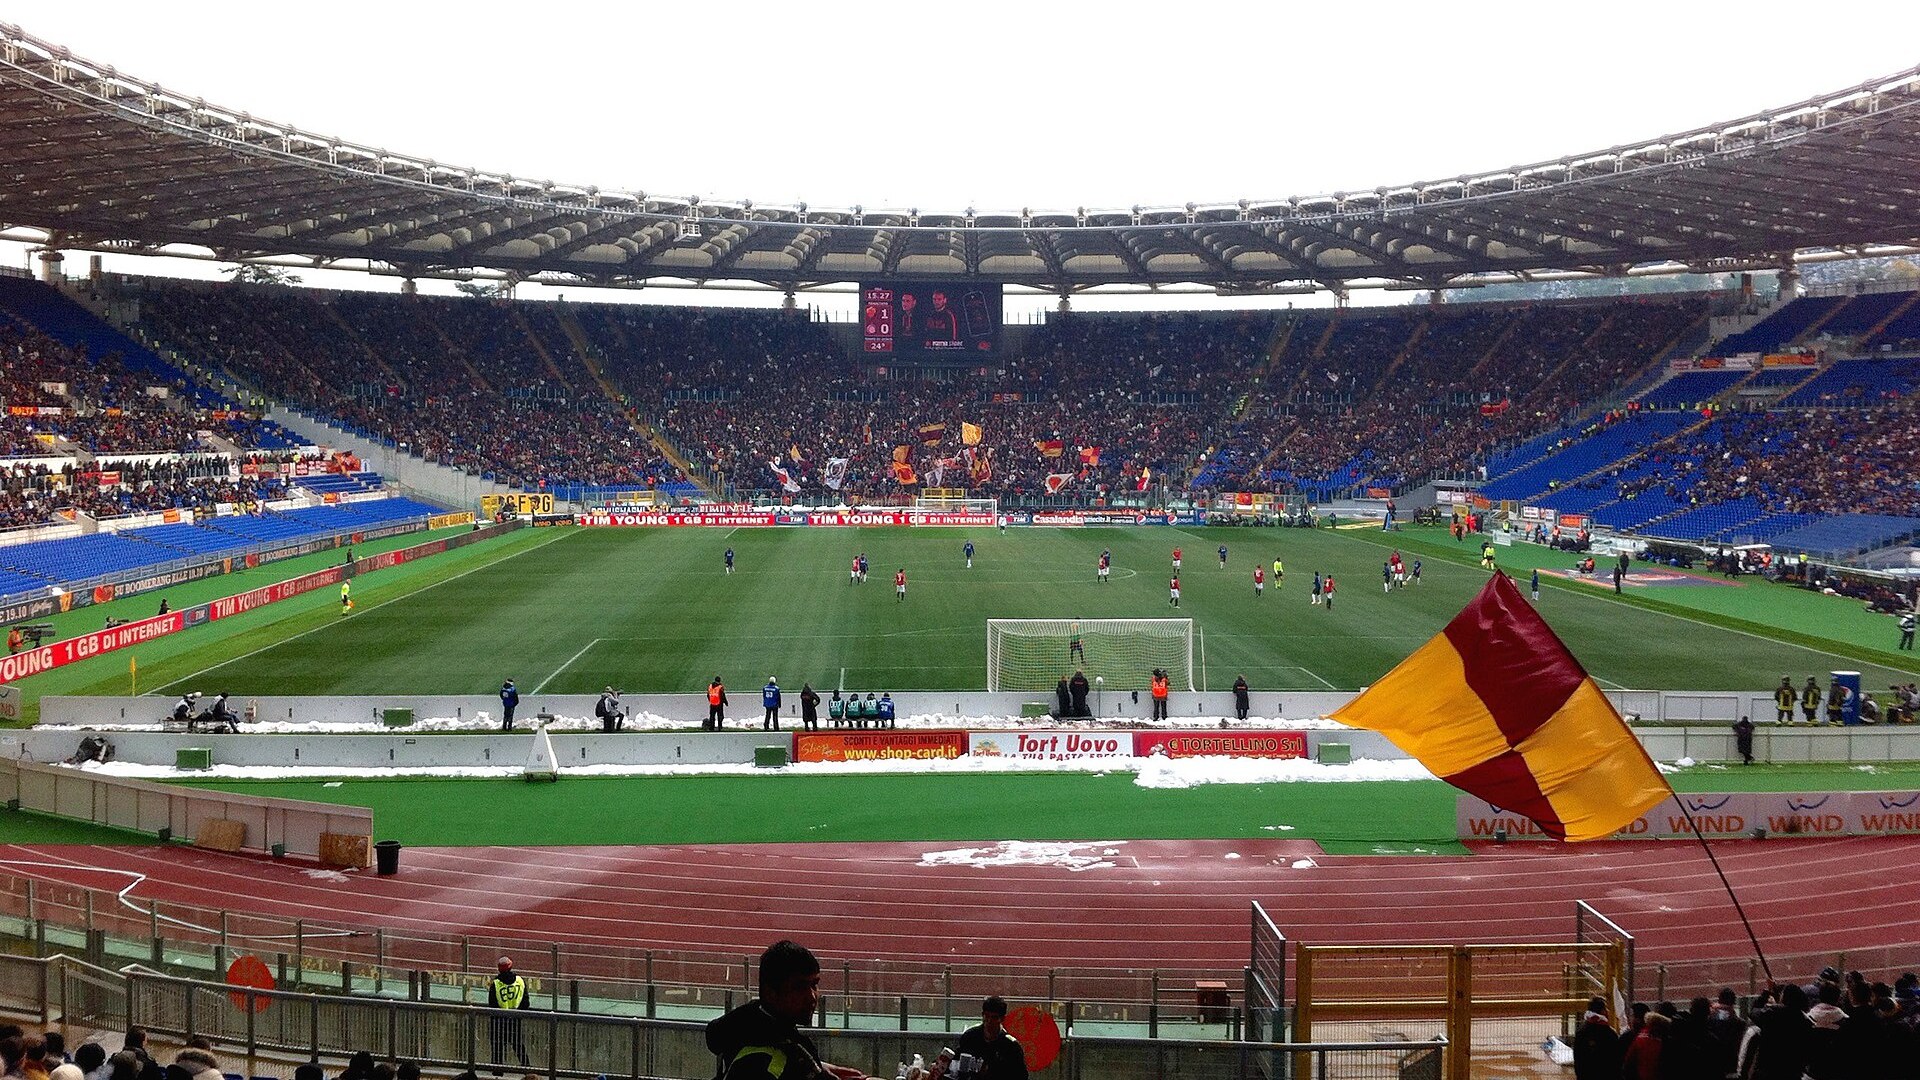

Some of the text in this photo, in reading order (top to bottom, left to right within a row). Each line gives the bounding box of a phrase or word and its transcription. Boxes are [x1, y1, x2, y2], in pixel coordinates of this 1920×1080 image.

[881, 308, 889, 319] 1
[880, 323, 889, 334] 0
[583, 515, 611, 525] TIM
[615, 515, 669, 525] YOUNG
[674, 516, 680, 525] 1
[683, 516, 702, 524] GB
[811, 515, 993, 525] TIM YOUNG 1 GB DI INTERNET
[1032, 514, 1084, 524] Casalandia
[125, 574, 171, 594] BOOMERANG
[215, 599, 235, 618] TIM
[238, 588, 270, 613] YOUNG
[283, 580, 295, 597] GB
[6, 605, 28, 622] 19.10
[65, 643, 73, 661] 1
[77, 634, 99, 657] GB
[103, 634, 116, 650] DI
[119, 616, 176, 645] INTERNET
[843, 736, 873, 746] SCONTI
[879, 736, 916, 745] VANTAGGI
[918, 735, 958, 745] IMMEDIATI
[1018, 734, 1118, 752] Tort Uovo
[1180, 738, 1278, 751] TORTELLINO
[1281, 737, 1303, 751] Srl
[844, 745, 958, 760] www.shop-card.it
[1667, 815, 1745, 833] WIND
[1860, 812, 1920, 831] WIN
